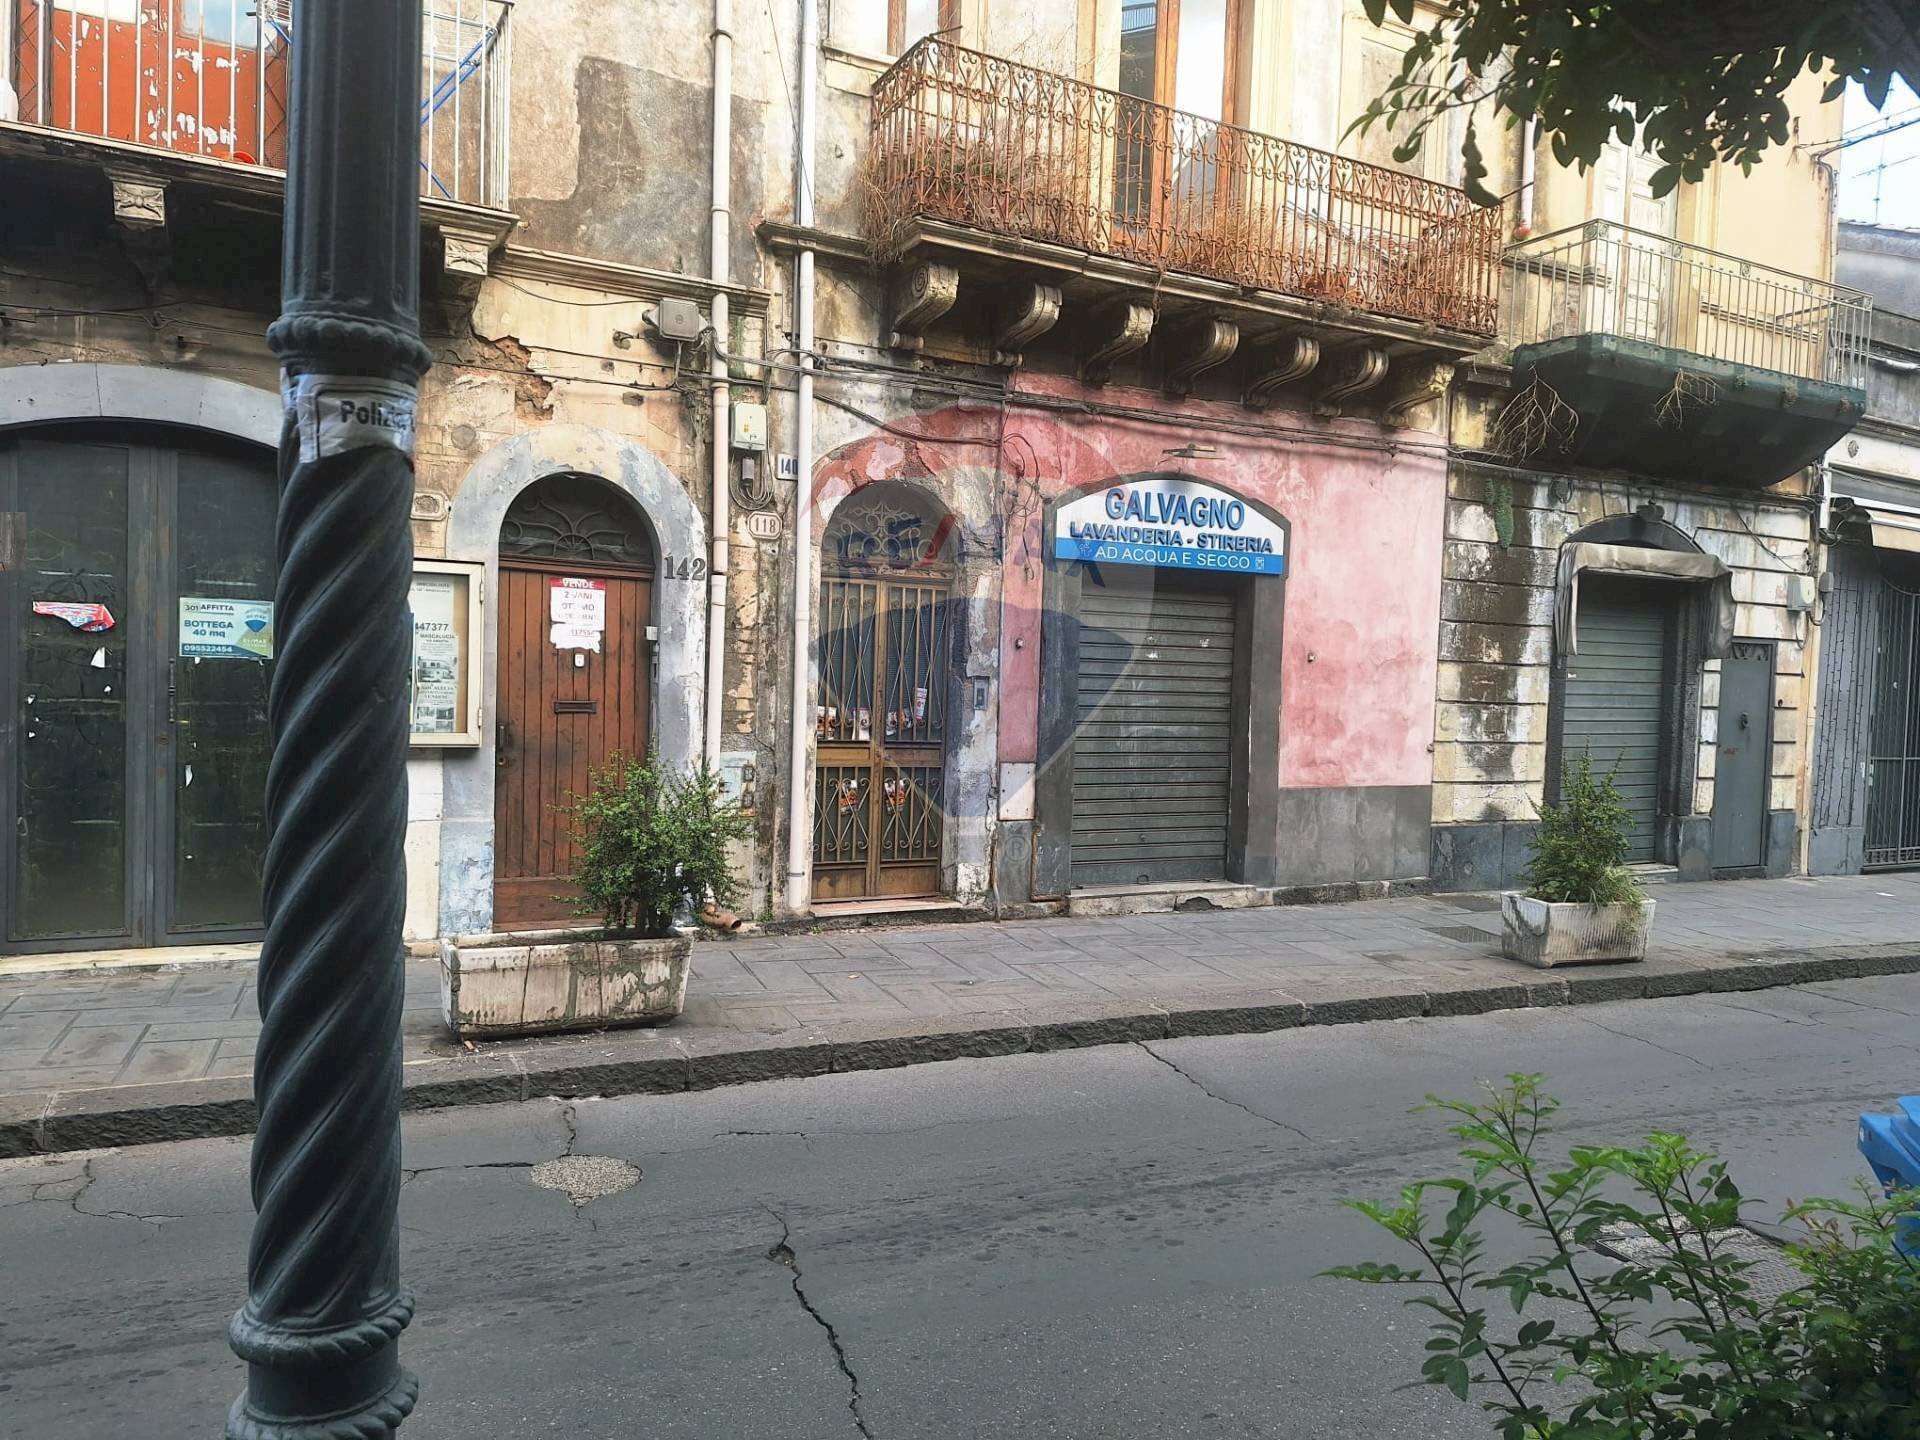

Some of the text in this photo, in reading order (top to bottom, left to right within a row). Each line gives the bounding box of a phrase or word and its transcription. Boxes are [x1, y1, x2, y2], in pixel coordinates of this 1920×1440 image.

[781, 458, 798, 475] 140
[1105, 487, 1245, 531] GALVAGNO
[755, 518, 776, 534] 118
[1070, 521, 1183, 546] LAVANDERIA
[1197, 532, 1274, 553] STIRERIA
[664, 555, 706, 581] 142
[1095, 545, 1250, 570] AD ACQUA E SECCO
[184, 620, 234, 629] BOTTEGA
[192, 628, 226, 638] 40 mq
